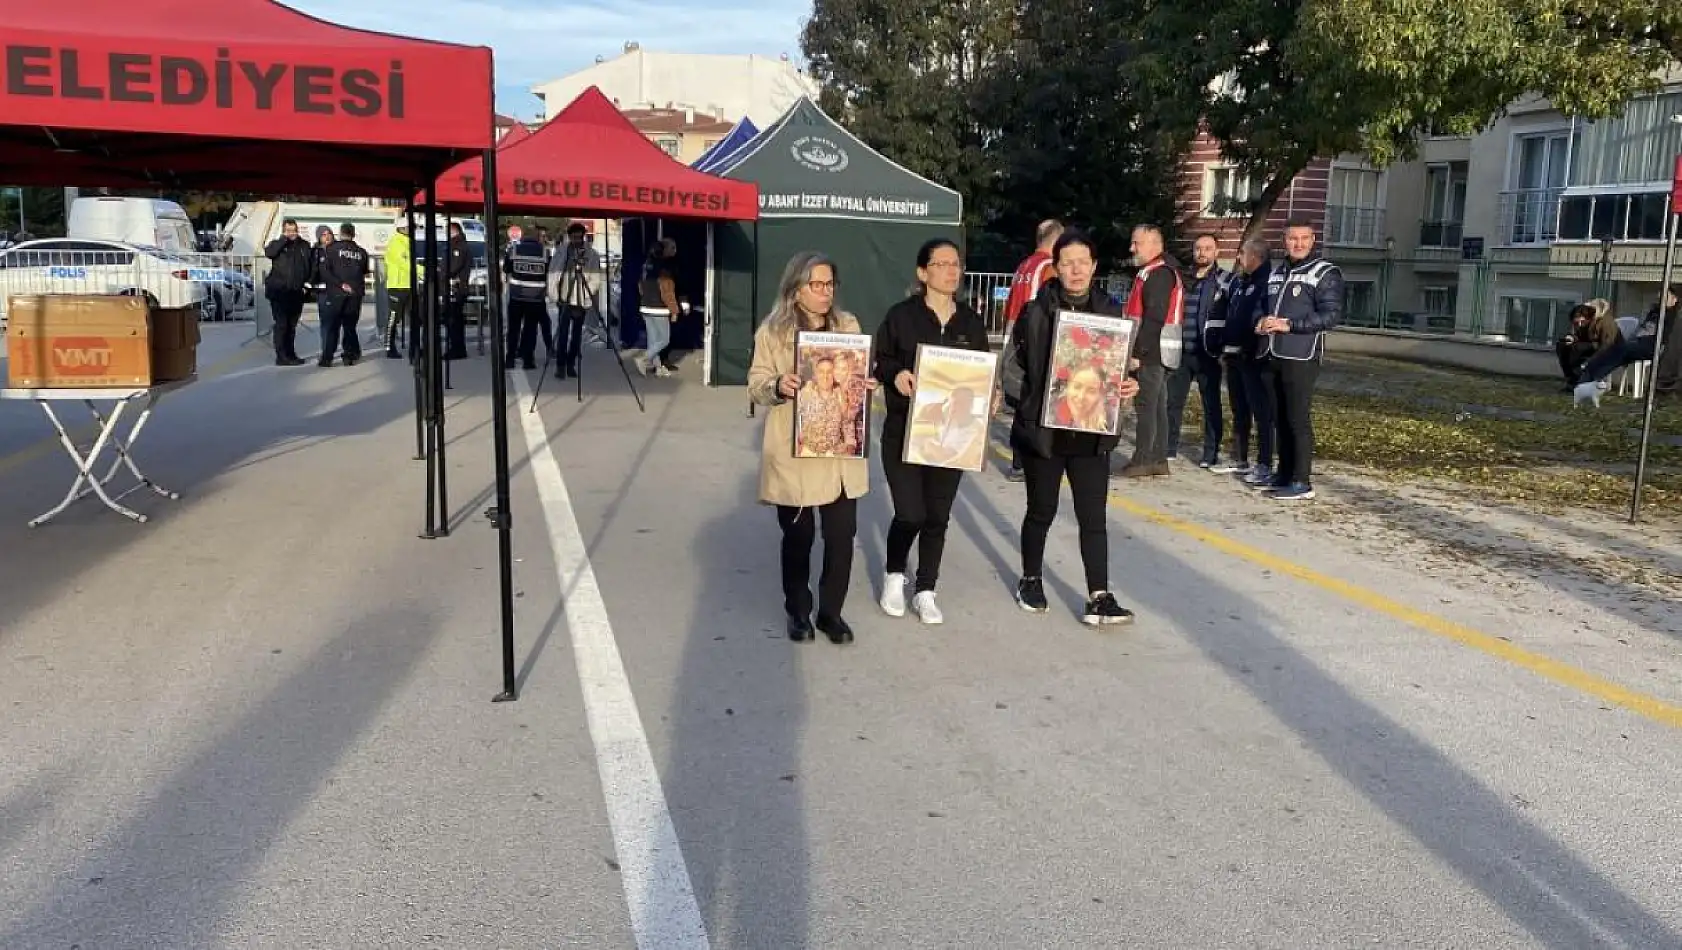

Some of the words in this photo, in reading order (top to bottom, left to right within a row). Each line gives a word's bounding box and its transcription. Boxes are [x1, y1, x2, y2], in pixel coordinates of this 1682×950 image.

[513, 178, 579, 198] BOLU
[590, 182, 730, 211] BELEDİYESİ
[769, 194, 799, 208] ABANT
[802, 192, 828, 209] İZZET
[830, 196, 865, 211] BAYSAL
[868, 197, 928, 216] ÜNİVERSİTESİ
[54, 348, 113, 367] YMT
